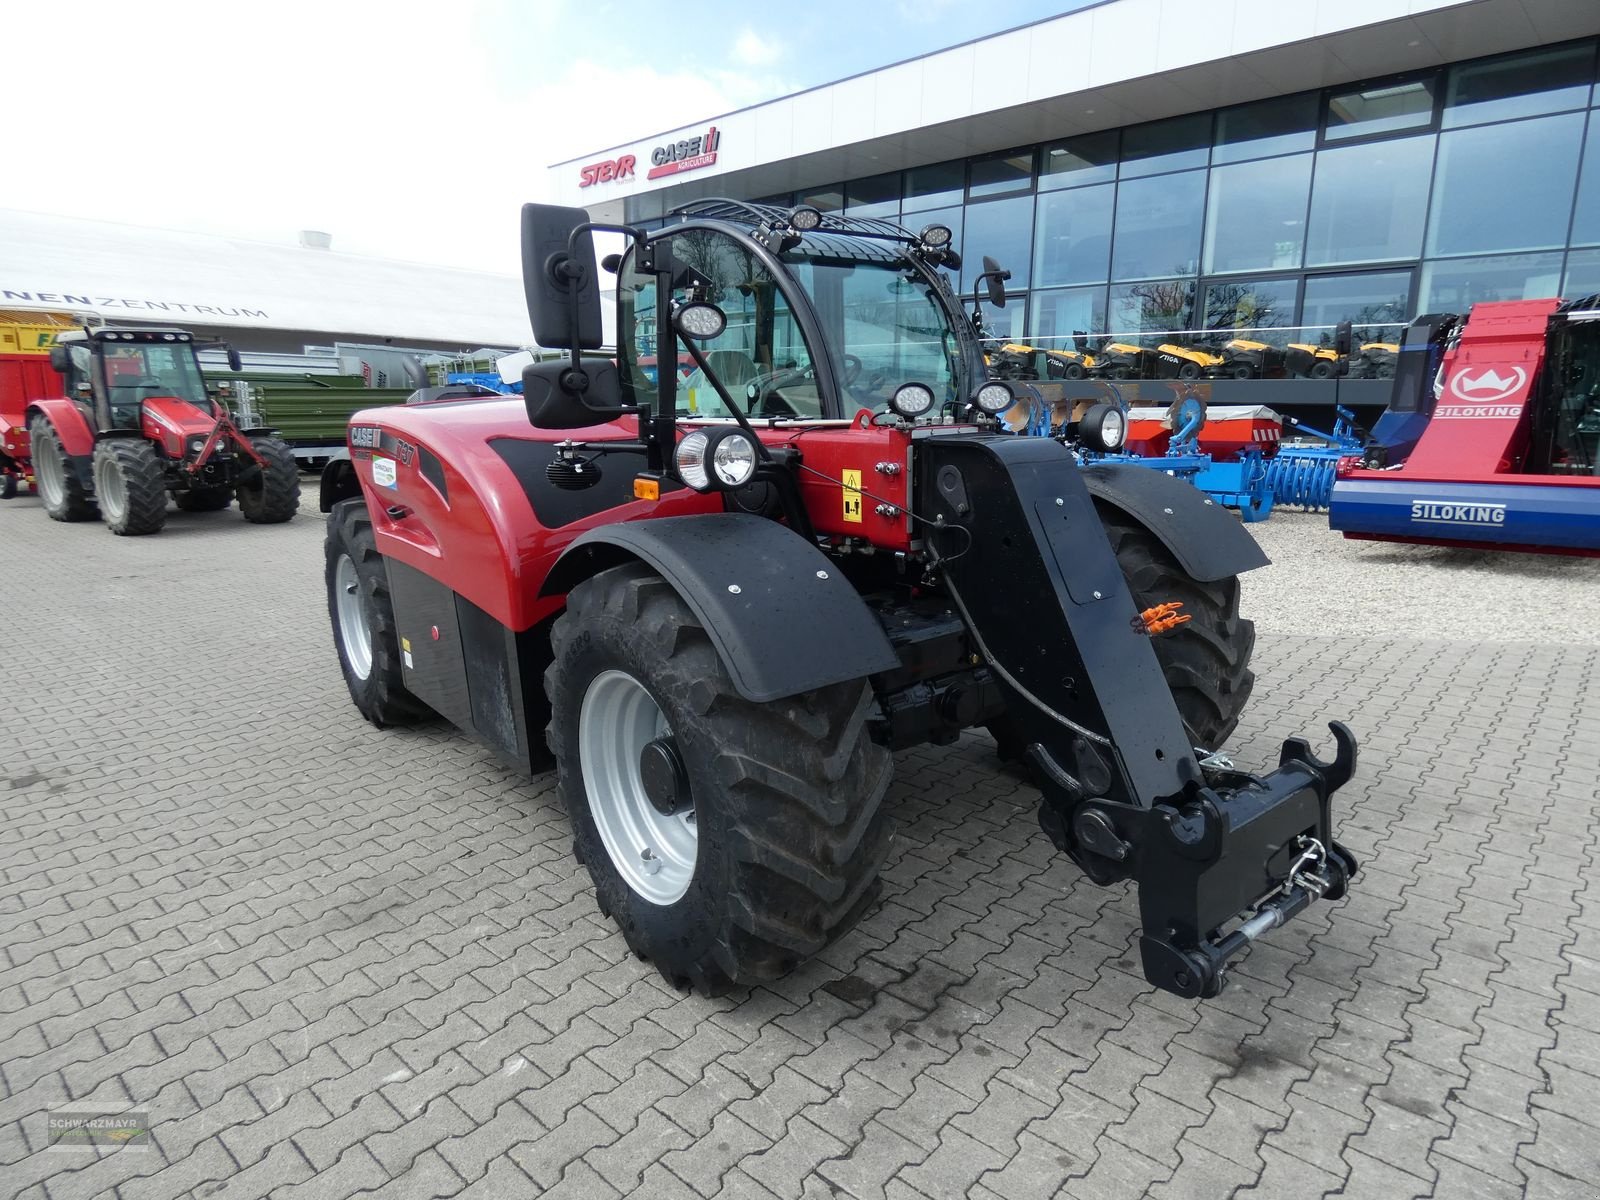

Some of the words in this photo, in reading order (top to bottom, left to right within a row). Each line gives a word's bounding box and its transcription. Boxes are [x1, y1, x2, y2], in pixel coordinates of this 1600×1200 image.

[651, 136, 701, 166] CASE
[579, 154, 636, 188] STEYR
[677, 155, 714, 171] AGRICULTURE
[1047, 358, 1064, 368] STIGA
[1159, 354, 1179, 364] STIGA
[1433, 407, 1522, 418] SILOKING
[351, 427, 373, 448] CASE
[1411, 504, 1506, 523] SILOKING
